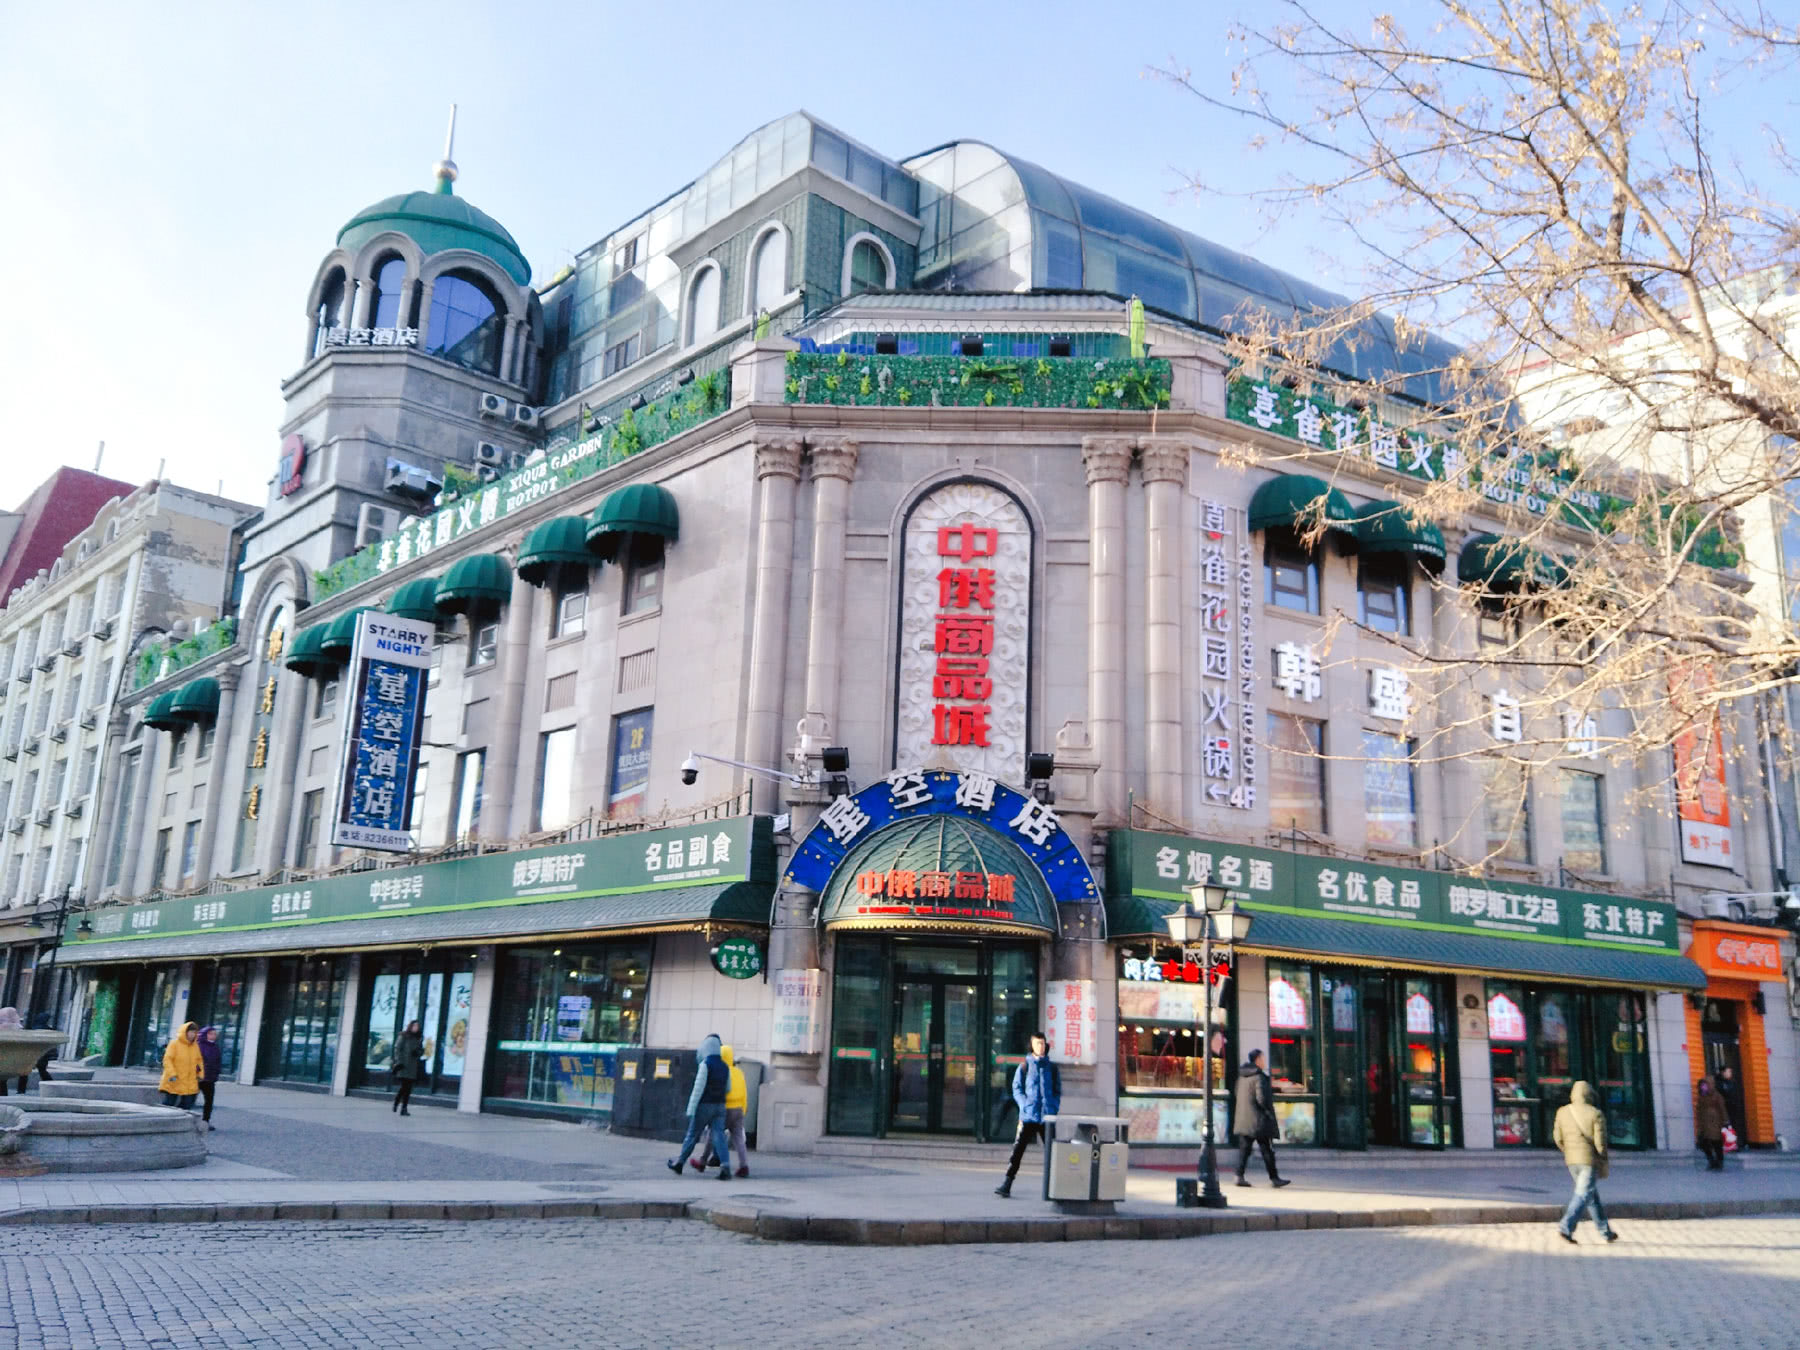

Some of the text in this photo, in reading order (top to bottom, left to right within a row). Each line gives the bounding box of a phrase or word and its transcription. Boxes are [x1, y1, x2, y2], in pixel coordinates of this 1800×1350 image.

[551, 434, 603, 470] GARDEN
[507, 475, 558, 512] HOTPOT
[369, 623, 429, 645] STARRY
[376, 639, 422, 657] NIGHT
[931, 523, 998, 747] 中俄商品城
[363, 672, 408, 818] 星空酒店
[819, 768, 1060, 845] 星空酒店
[513, 853, 586, 887] 俄罗斯特产
[645, 831, 732, 871] 名品副食
[1156, 846, 1273, 891] 名烟名酒
[369, 874, 424, 903] 中华老字号
[1318, 868, 1421, 909] 名优食品
[1448, 885, 1560, 926] 俄罗斯工艺品
[1582, 902, 1665, 936] 东北特产
